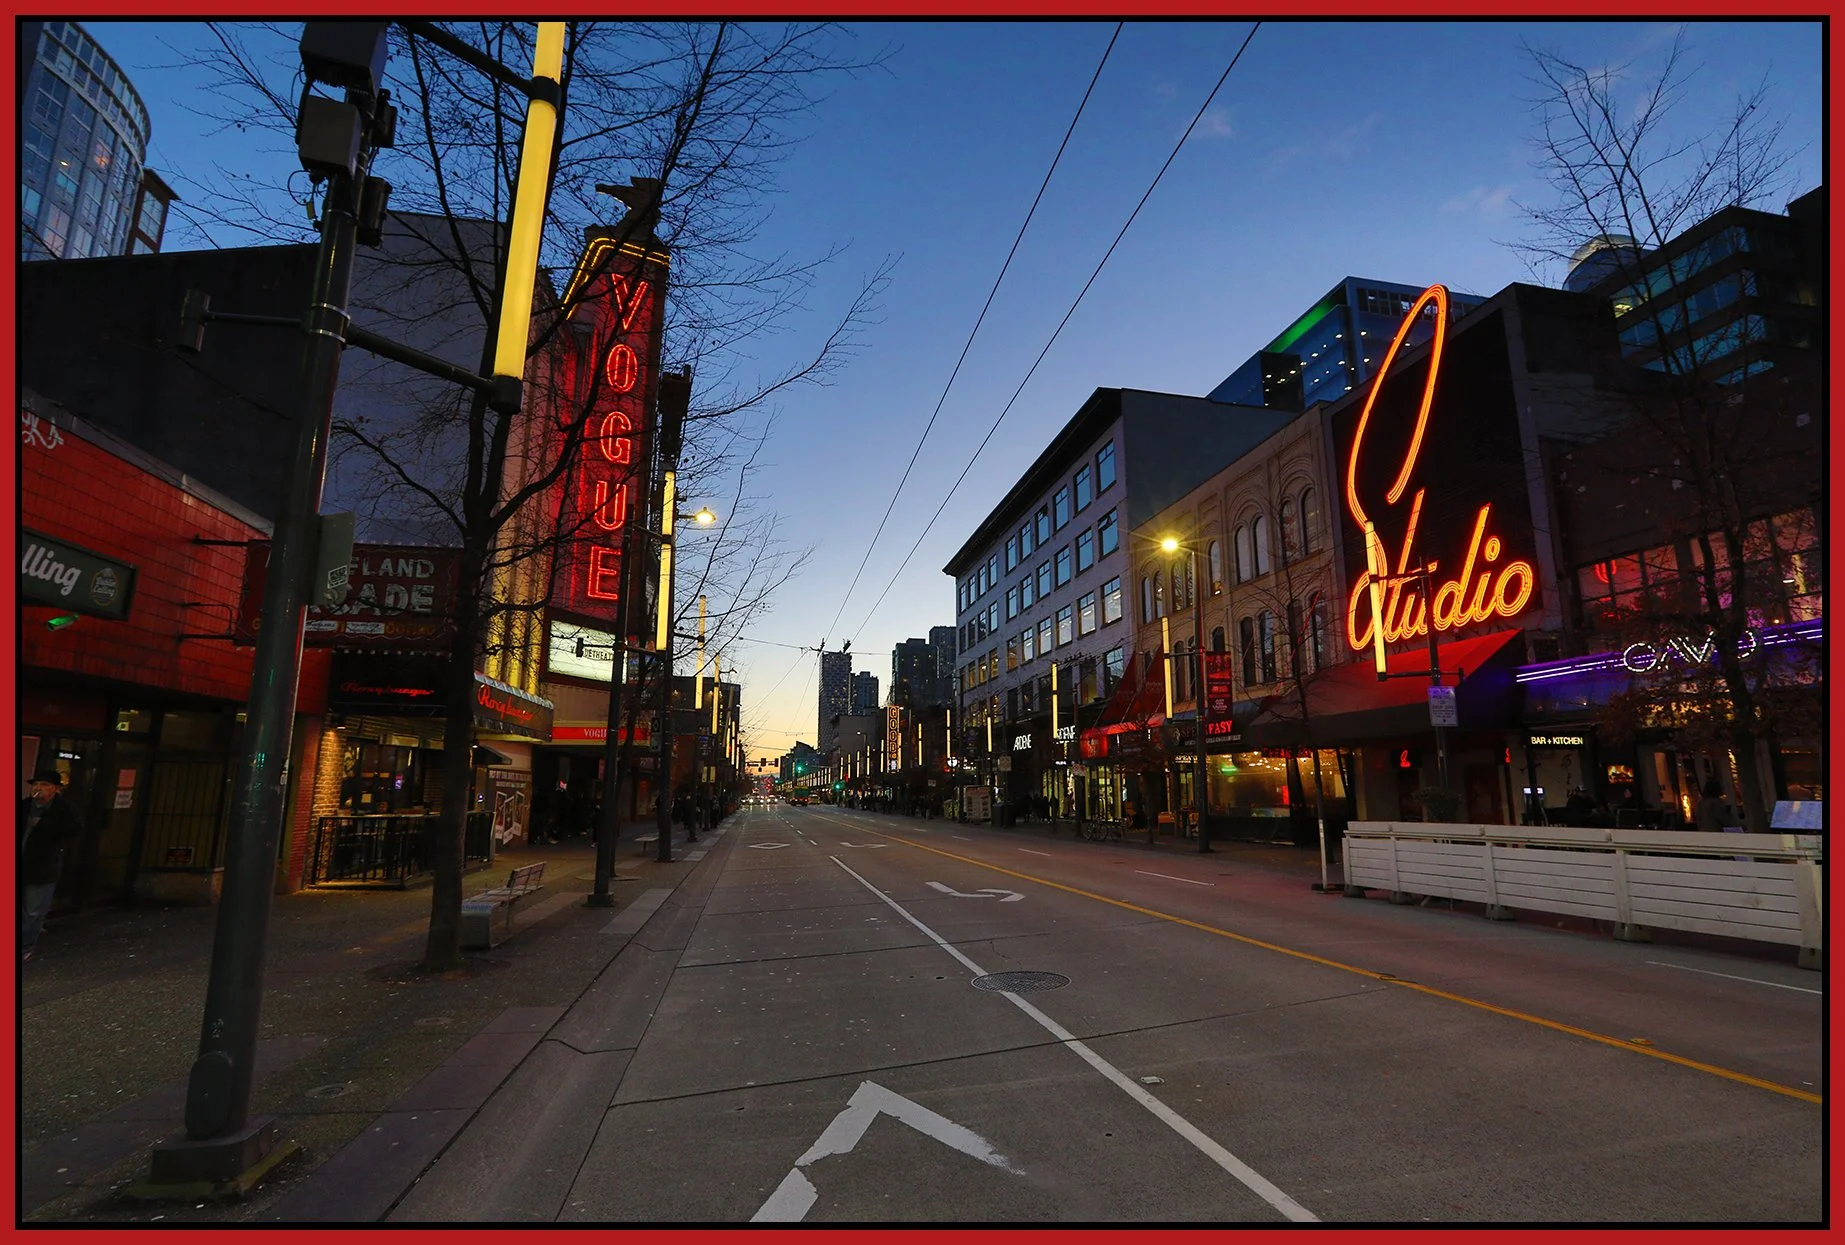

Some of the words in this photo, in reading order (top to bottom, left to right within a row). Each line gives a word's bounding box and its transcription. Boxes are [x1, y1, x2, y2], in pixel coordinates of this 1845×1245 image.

[588, 273, 648, 600] VOGUE
[1347, 284, 1535, 651] Studio
[22, 543, 82, 597] lling
[347, 556, 436, 579] ELAND
[583, 728, 608, 739] VOGU
[1530, 736, 1547, 745] BAR
[1552, 736, 1584, 745] KITCHEN
